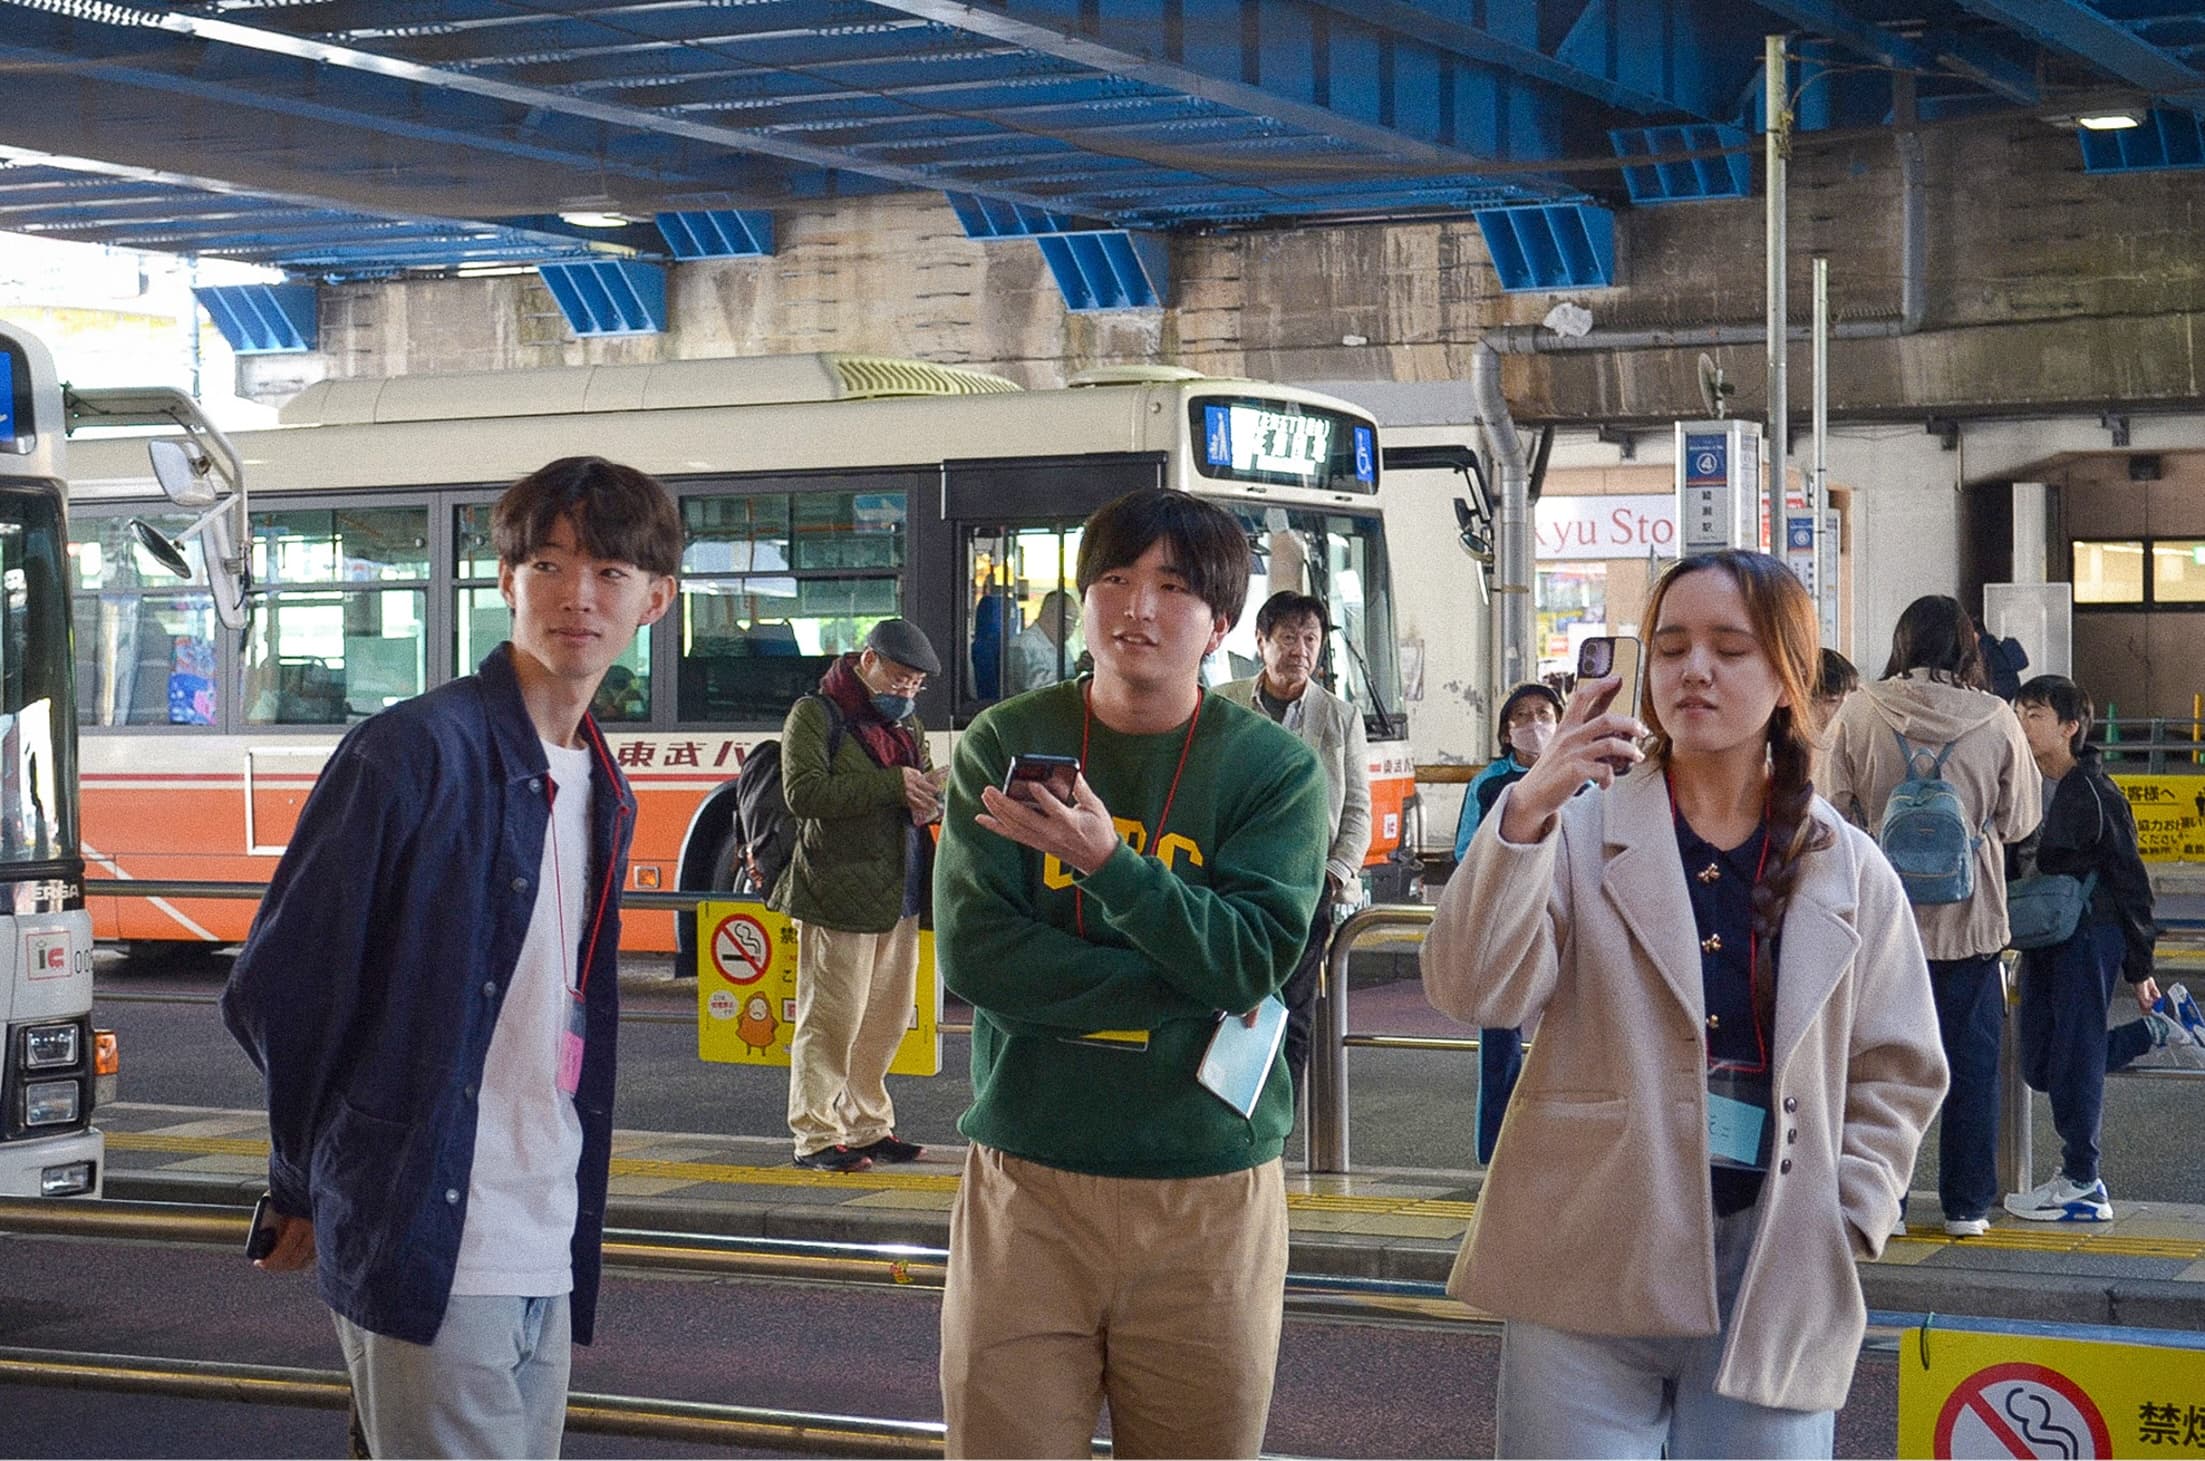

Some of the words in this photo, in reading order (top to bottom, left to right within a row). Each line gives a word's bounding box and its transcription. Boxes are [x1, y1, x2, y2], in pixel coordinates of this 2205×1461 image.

[1611, 508, 1674, 545] Sto
[617, 741, 751, 767] 東武バ
[780, 927, 798, 944] 禁
